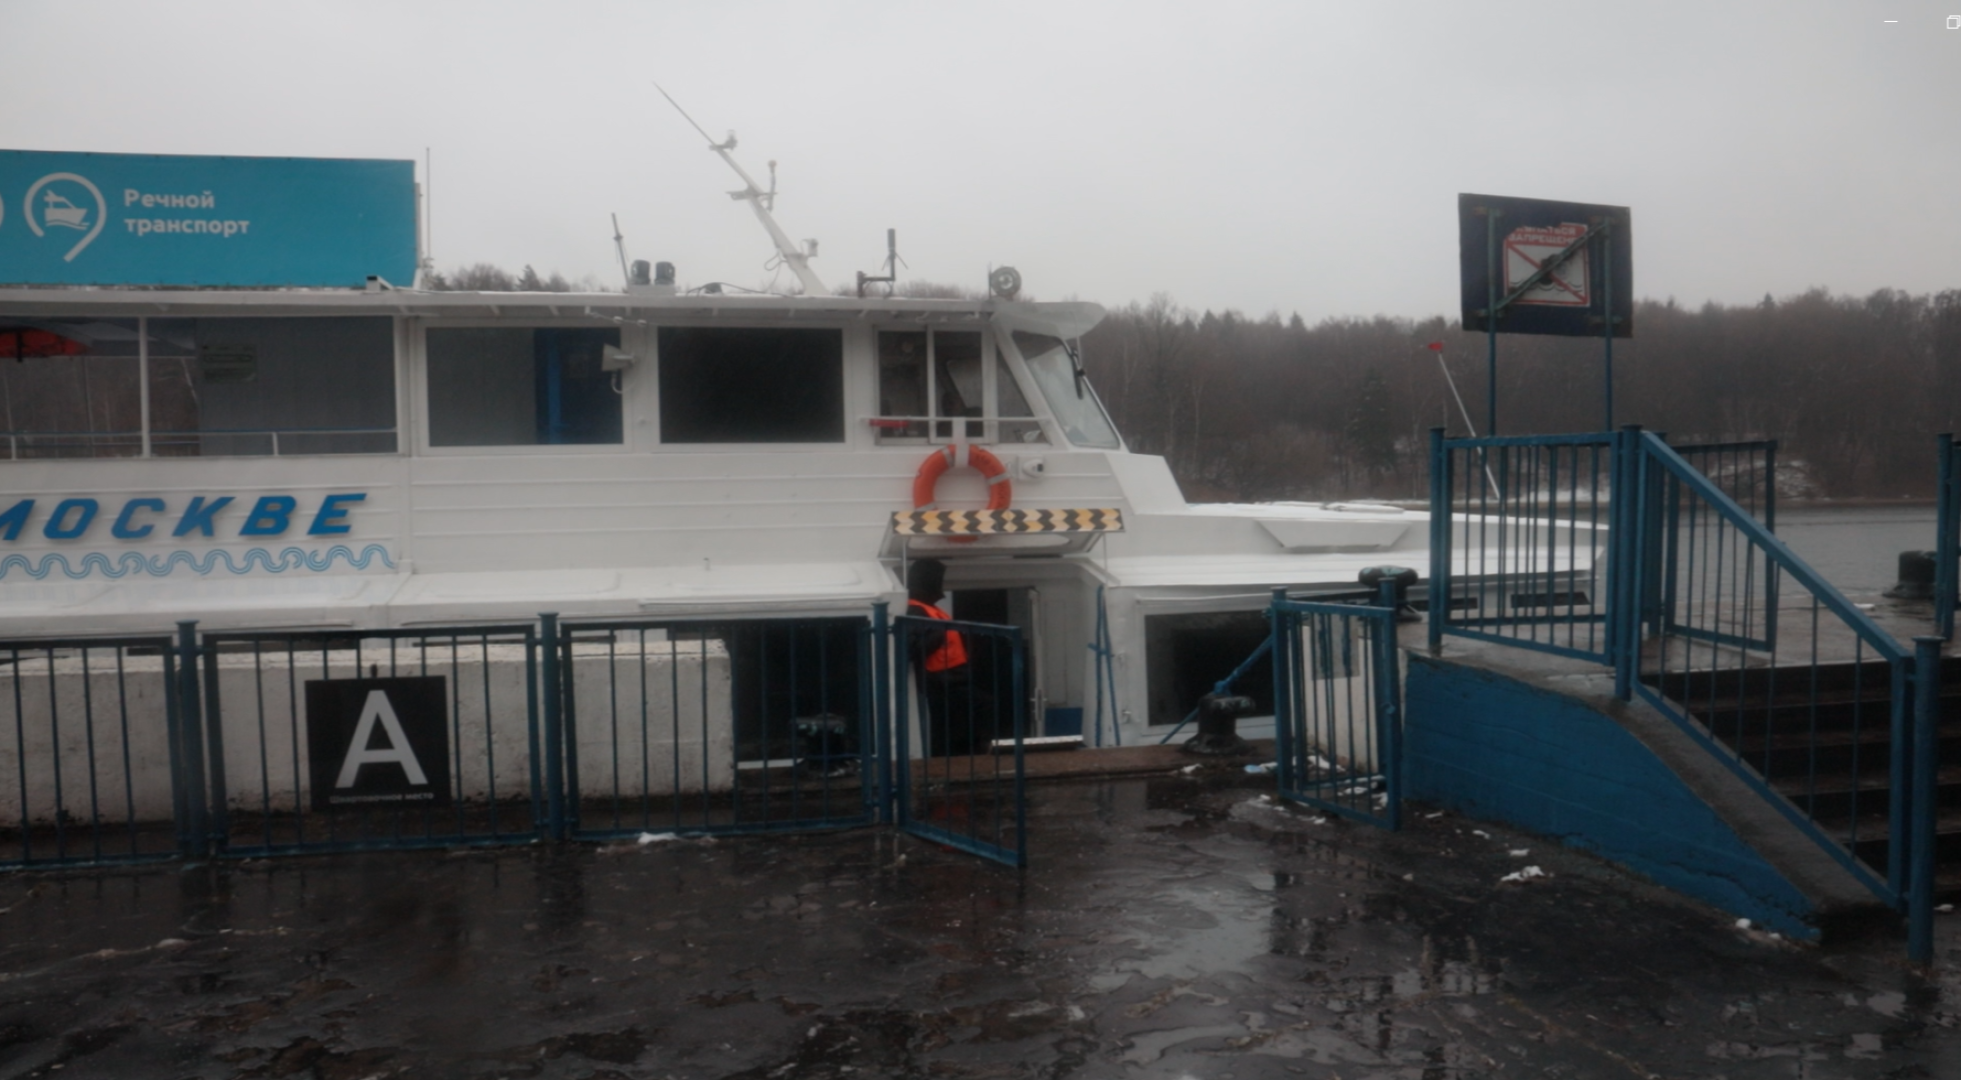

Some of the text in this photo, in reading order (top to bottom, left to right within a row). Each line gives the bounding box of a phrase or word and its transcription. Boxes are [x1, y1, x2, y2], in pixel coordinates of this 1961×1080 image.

[124, 188, 215, 209] Речной
[124, 218, 250, 238] транспорт
[1507, 233, 1578, 245] ЗАПРЕЩЕН
[335, 689, 429, 789] А
